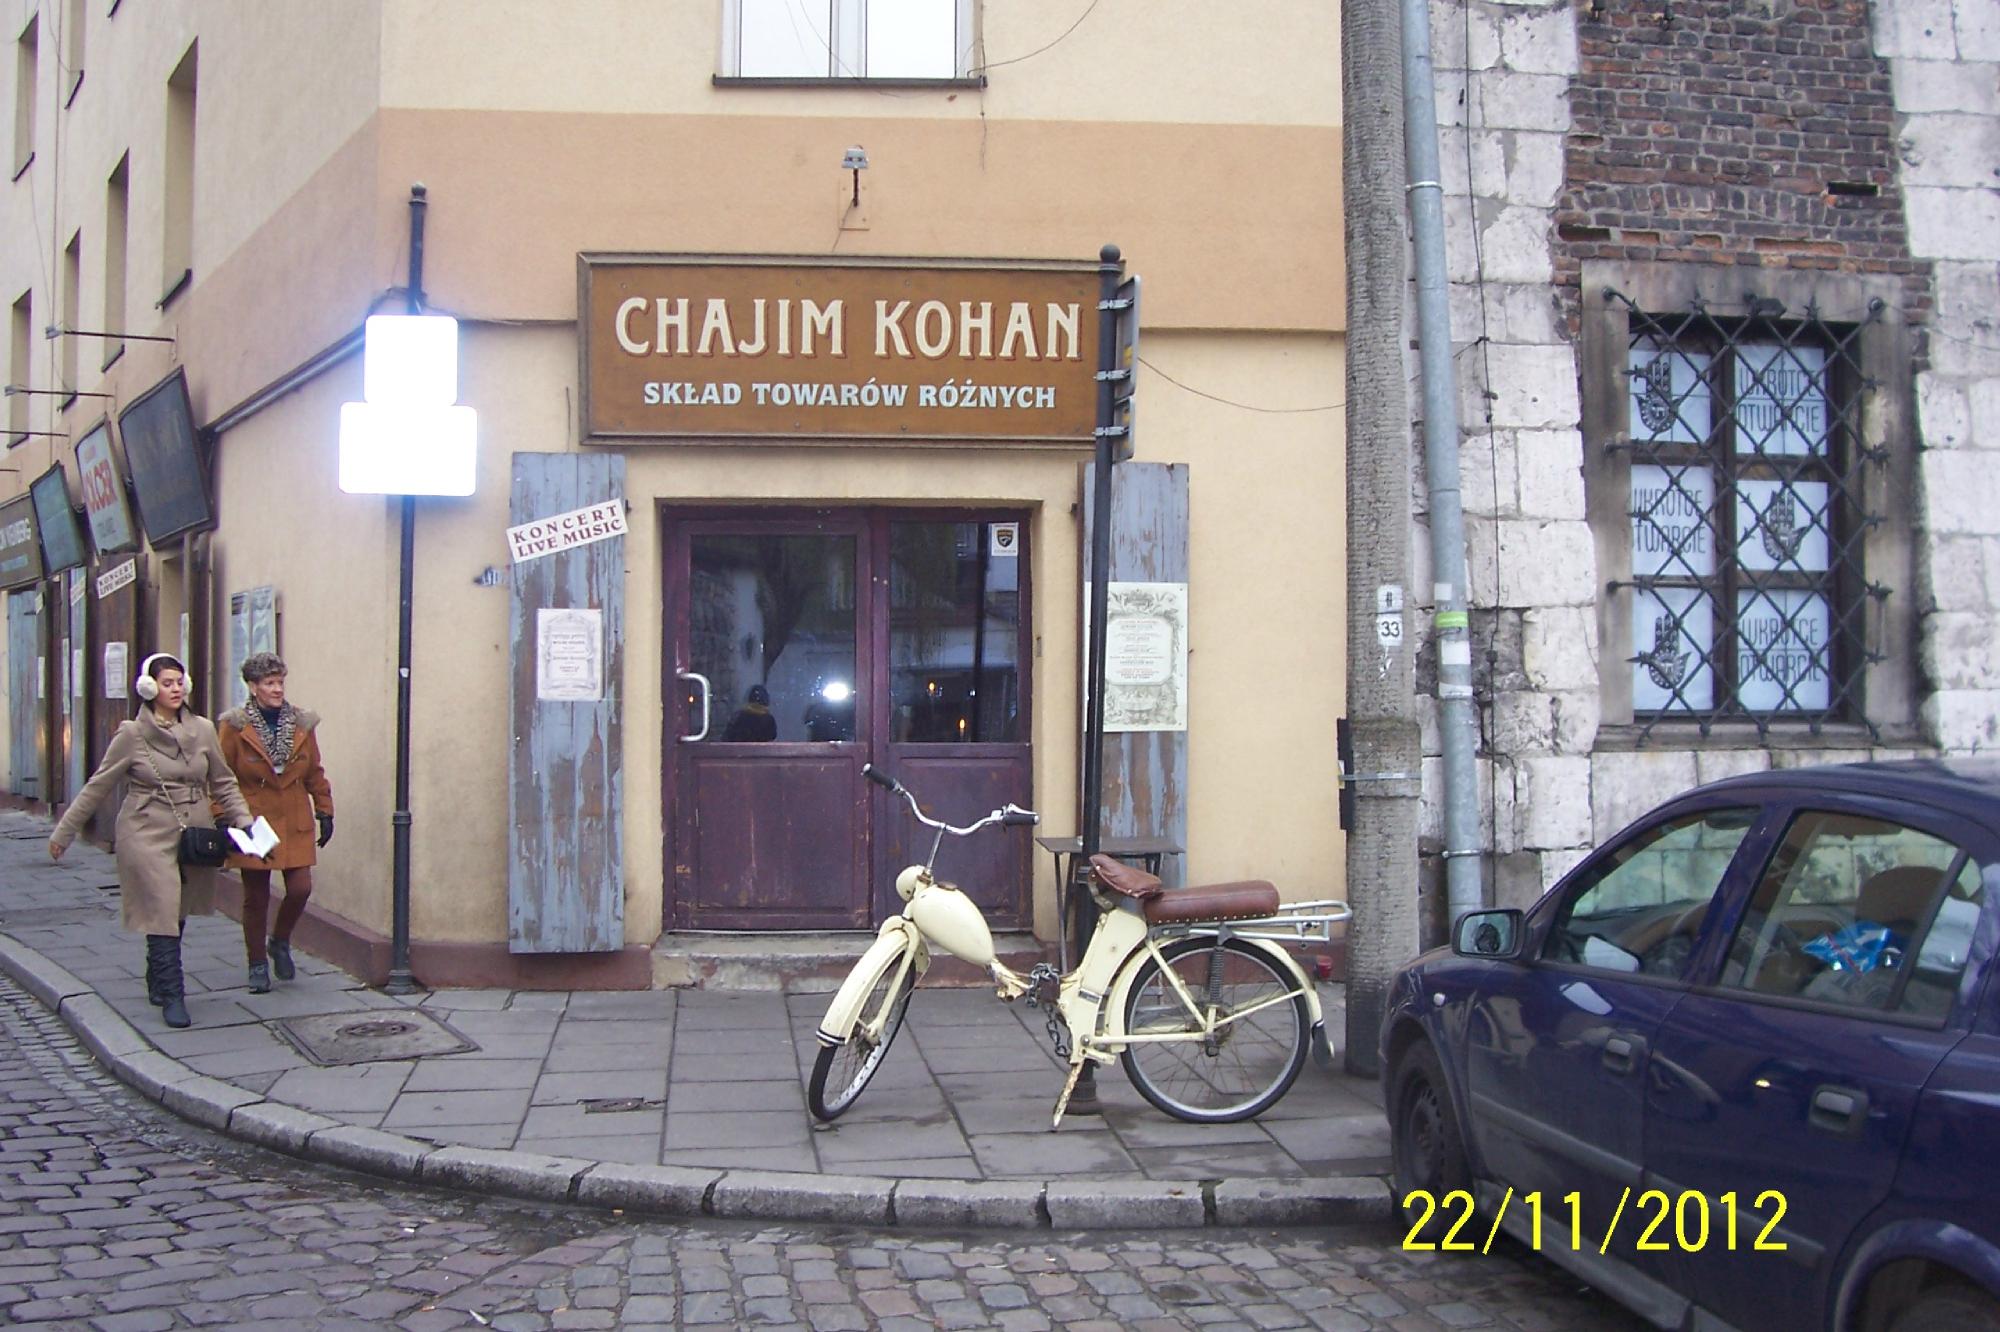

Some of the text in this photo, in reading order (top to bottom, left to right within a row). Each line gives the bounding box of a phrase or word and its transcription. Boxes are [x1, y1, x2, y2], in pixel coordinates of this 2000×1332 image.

[615, 297, 1083, 359] CHAJIM KOHAN
[643, 377, 1056, 409] SKŁAD TOWARÓW RÓŻNYCH
[514, 505, 618, 544] KONCERT
[517, 519, 622, 557] LIVE MUSIC
[1381, 621, 1400, 637] 33
